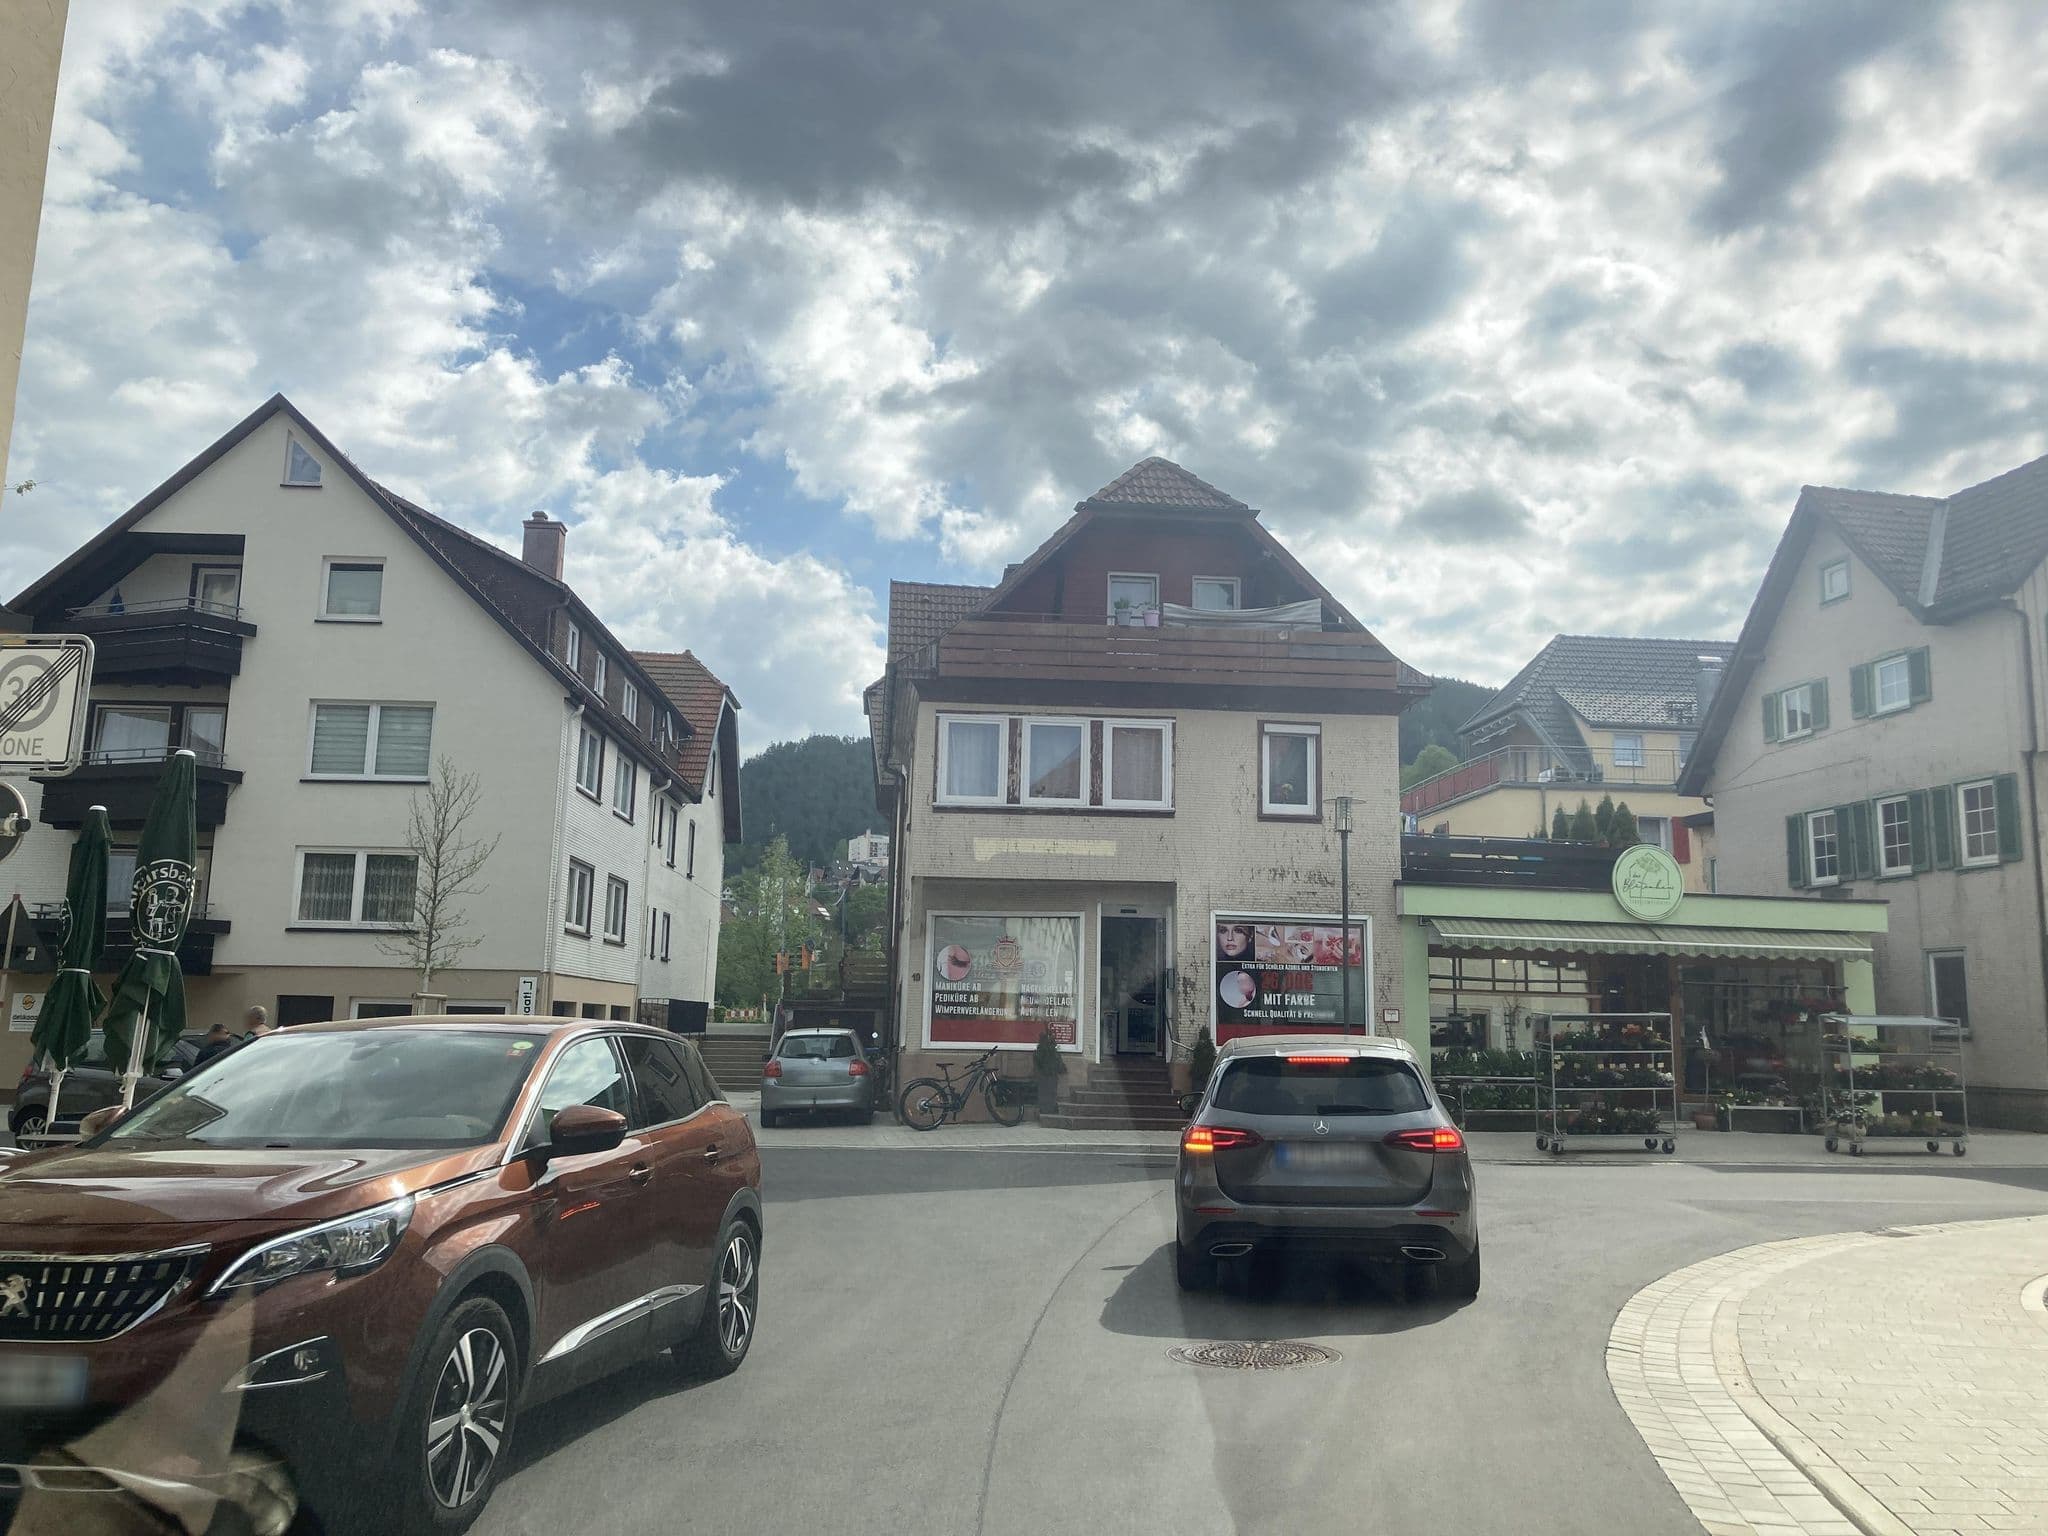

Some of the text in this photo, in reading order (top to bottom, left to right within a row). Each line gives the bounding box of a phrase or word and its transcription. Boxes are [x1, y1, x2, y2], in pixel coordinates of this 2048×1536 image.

[4, 676, 44, 711] 30
[0, 737, 45, 756] ONE
[1264, 994, 1315, 1006] MIT FARBE
[935, 1004, 1014, 1017] WIMPERNVERLÄNGERUN
[1244, 1009, 1268, 1018] SCHNELL
[1270, 1010, 1296, 1018] QUALITÄT
